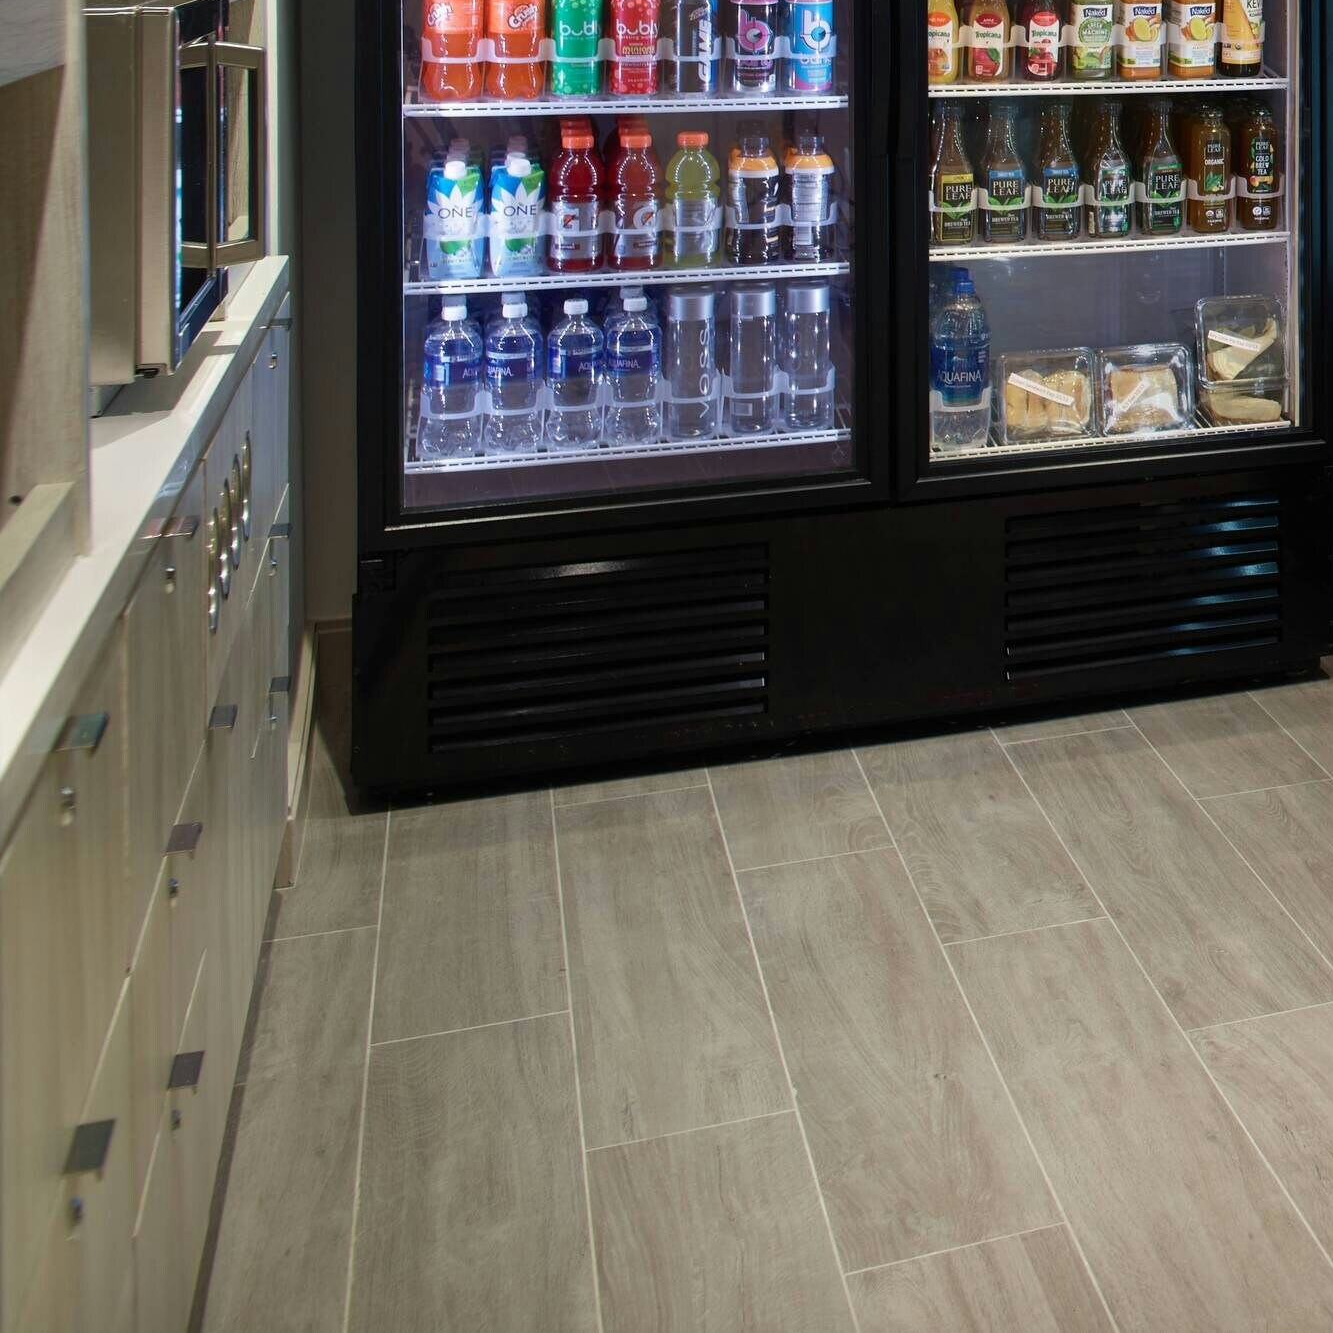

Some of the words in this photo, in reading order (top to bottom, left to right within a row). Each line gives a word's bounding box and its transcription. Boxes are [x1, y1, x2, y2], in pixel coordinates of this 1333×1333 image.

[1085, 8, 1107, 17] Naked
[1135, 7, 1157, 16] Naked
[1191, 7, 1211, 16] Naked
[928, 30, 951, 39] opicana
[975, 30, 1002, 39] Tropicana
[1032, 29, 1058, 38] Tropicana
[1204, 158, 1225, 166] ORGANIC
[1257, 168, 1268, 176] TEA
[1048, 178, 1073, 186] PURE
[1155, 174, 1180, 183] PURE
[946, 184, 972, 194] PURE
[993, 180, 1019, 189] PURE
[1155, 181, 1180, 190] LEAF
[699, 328, 712, 420] VOSS
